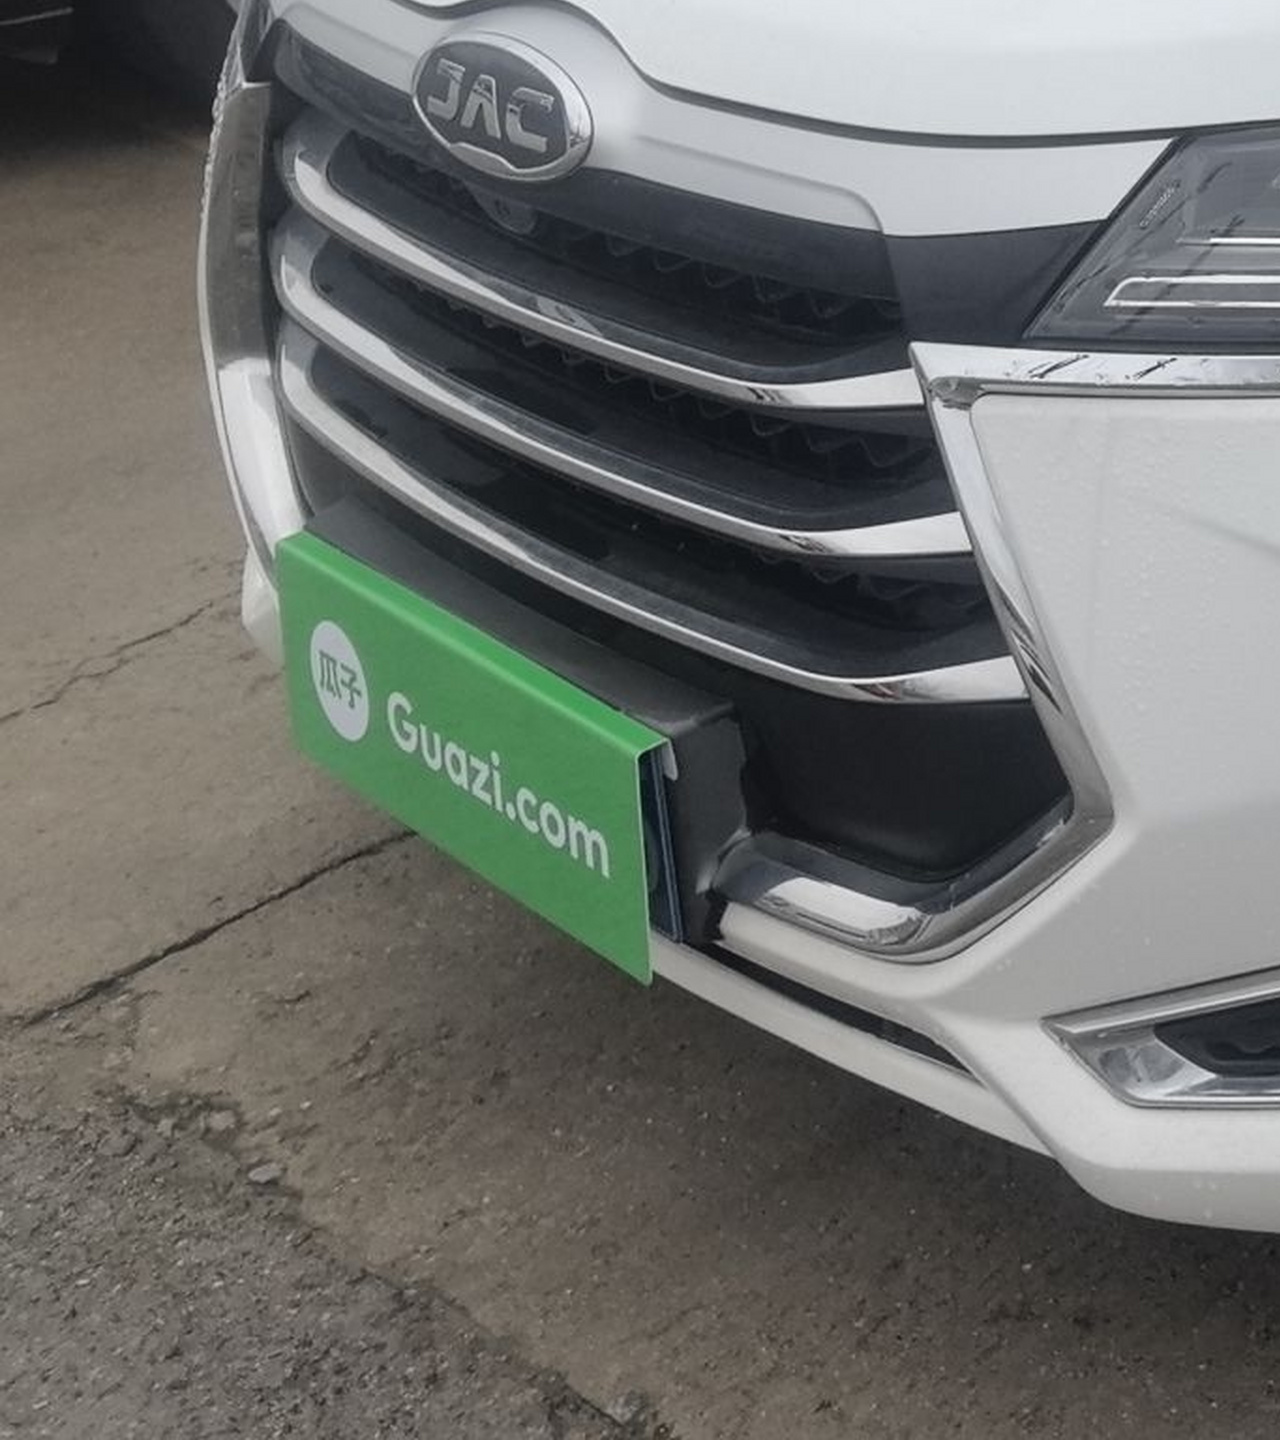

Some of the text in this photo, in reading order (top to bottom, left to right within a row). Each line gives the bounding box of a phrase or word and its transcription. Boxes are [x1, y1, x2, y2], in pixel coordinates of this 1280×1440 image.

[426, 58, 555, 153] JAC
[319, 649, 362, 710] 瓜子
[387, 690, 609, 879] Guazi.com
